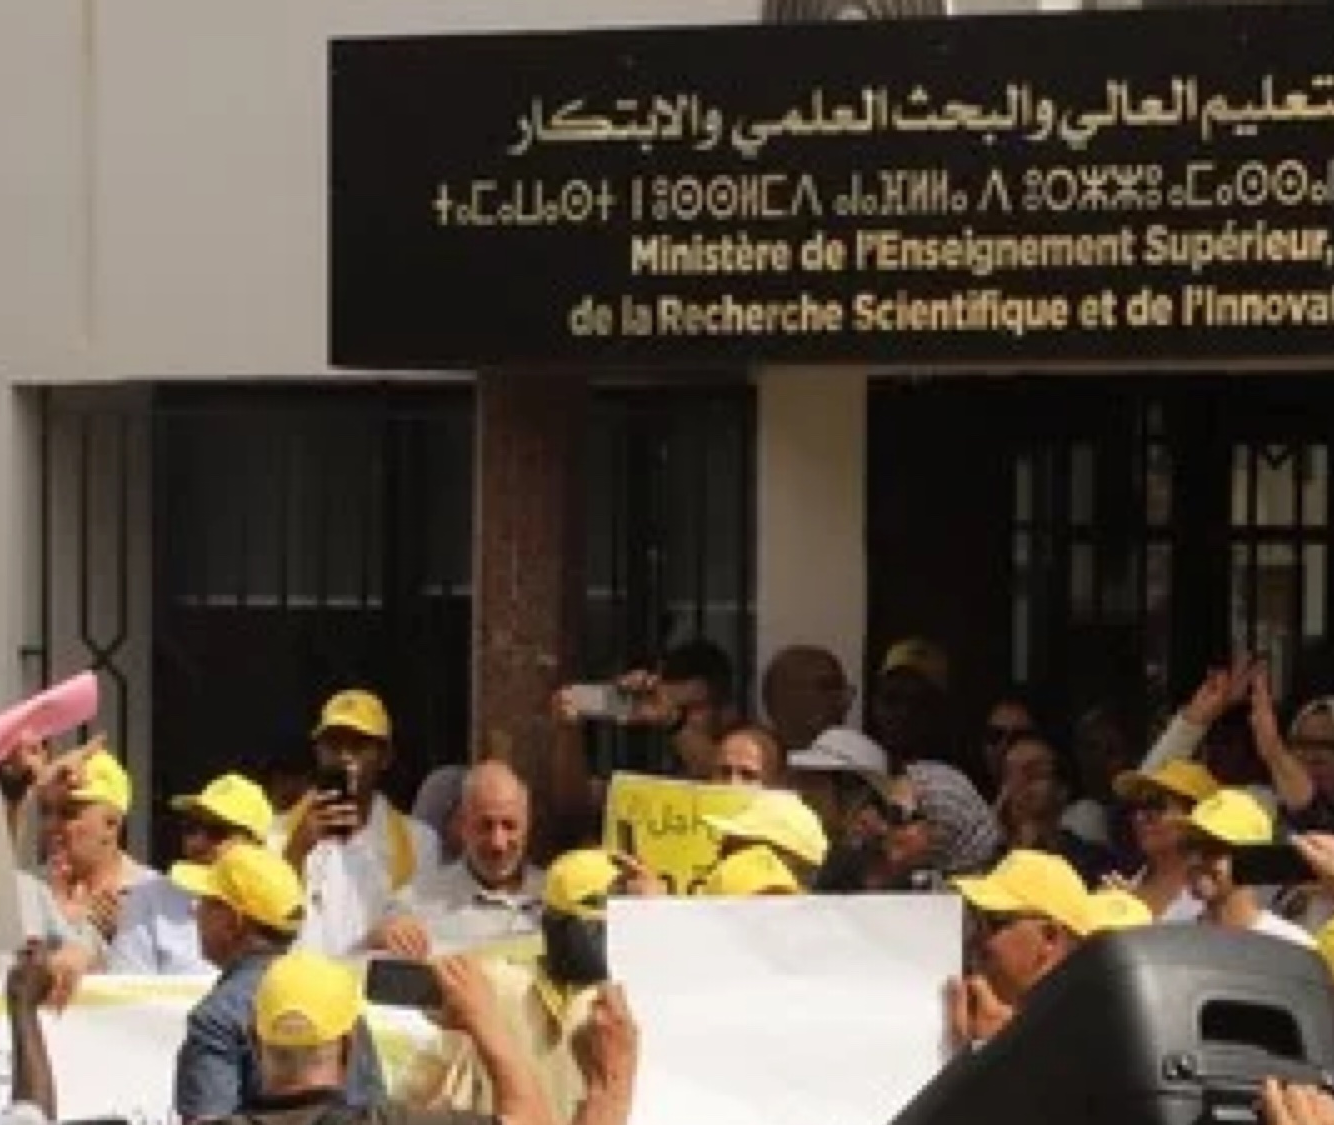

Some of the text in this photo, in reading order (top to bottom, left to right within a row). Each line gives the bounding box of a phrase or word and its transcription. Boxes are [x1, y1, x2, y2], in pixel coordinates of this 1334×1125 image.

[510, 95, 722, 155] والابتكار
[732, 88, 887, 156] العلمي
[892, 85, 1056, 145] والبحث
[1059, 78, 1197, 150] العالي
[632, 232, 790, 275] Ministère
[801, 230, 847, 270] de
[857, 227, 1137, 275] l'Enseignement
[571, 296, 612, 335] de
[622, 296, 652, 335] la
[657, 293, 843, 334] Recherche
[852, 290, 1069, 336] Scientifique
[1077, 290, 1117, 329] et
[1126, 286, 1172, 326] de
